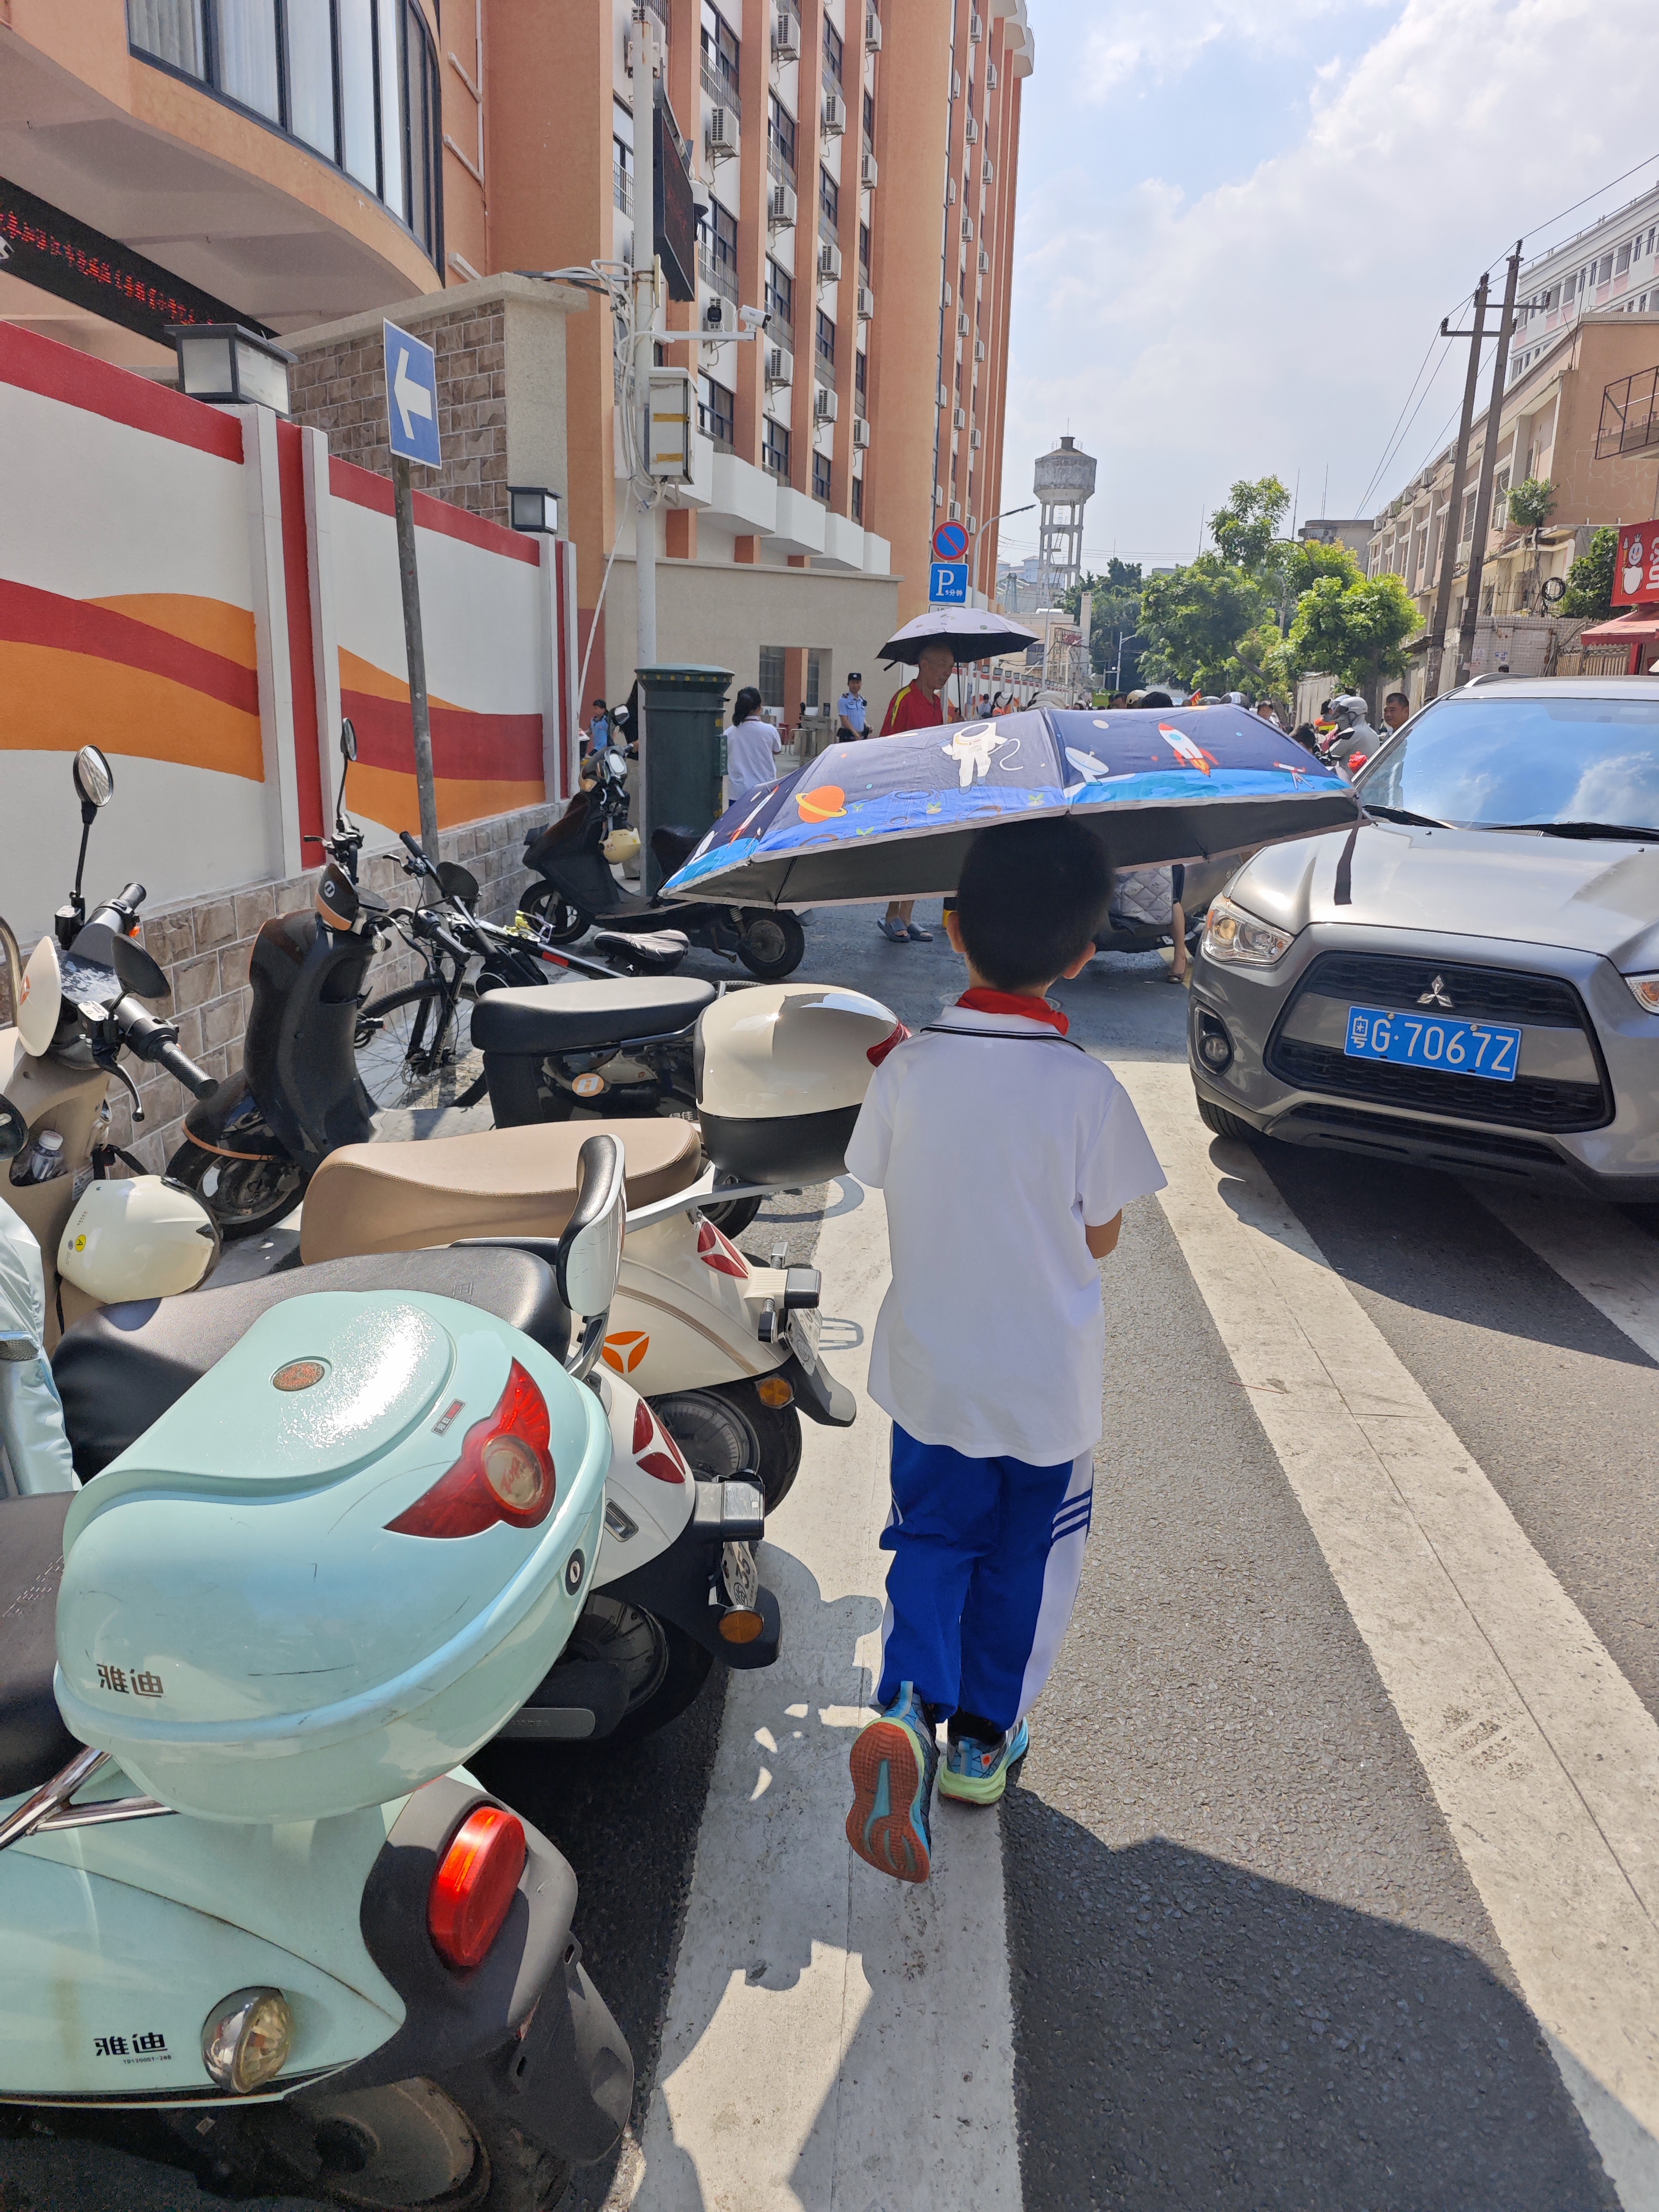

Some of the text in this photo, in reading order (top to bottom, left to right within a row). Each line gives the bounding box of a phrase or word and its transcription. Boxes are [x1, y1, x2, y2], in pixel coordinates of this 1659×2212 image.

[935, 569, 955, 597] P
[945, 588, 963, 597] 5分钟
[96, 1663, 164, 1698] 雅迪
[93, 2032, 168, 2056] 雅迪
